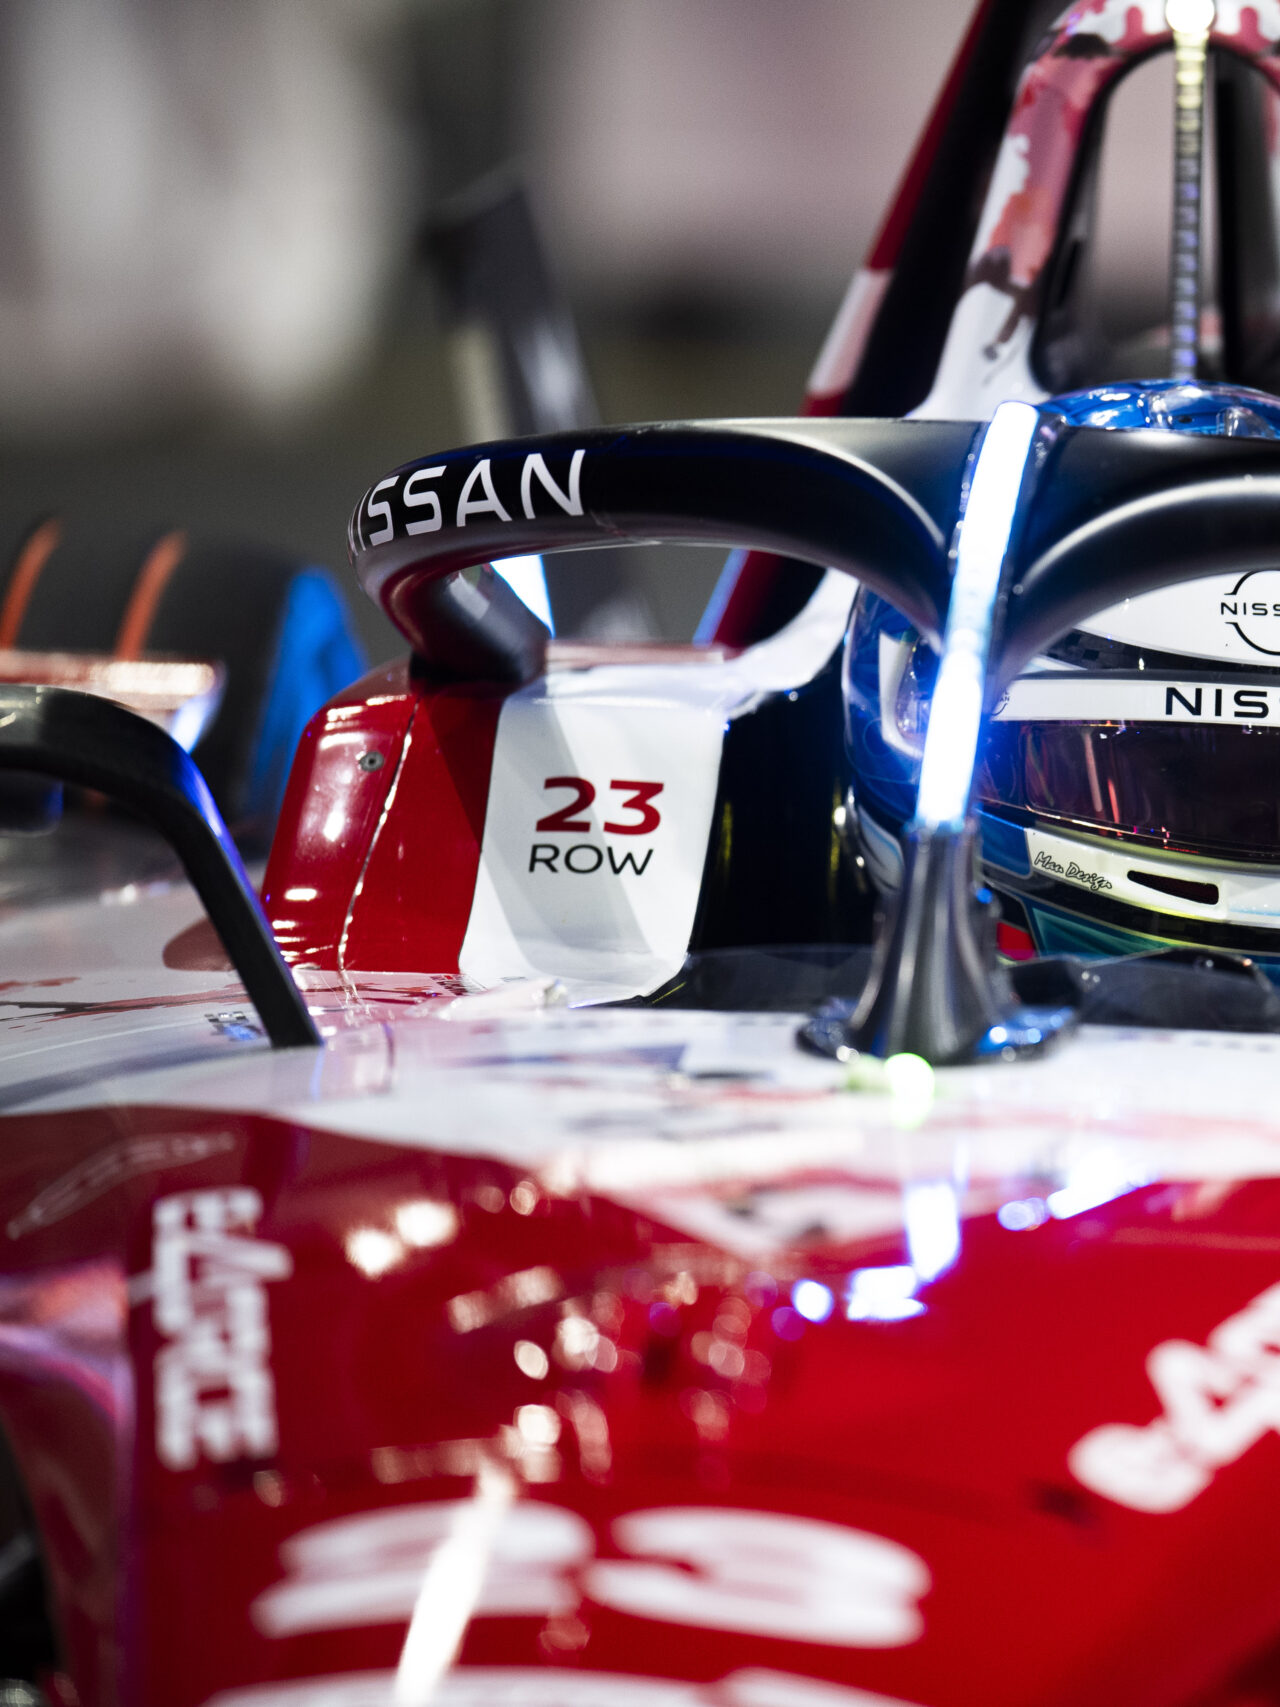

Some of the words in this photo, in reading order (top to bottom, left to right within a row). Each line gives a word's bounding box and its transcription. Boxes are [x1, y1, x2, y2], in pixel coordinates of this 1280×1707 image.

[536, 775, 665, 836] 23
[528, 844, 654, 876] ROW
[1065, 861, 1113, 892] Design
